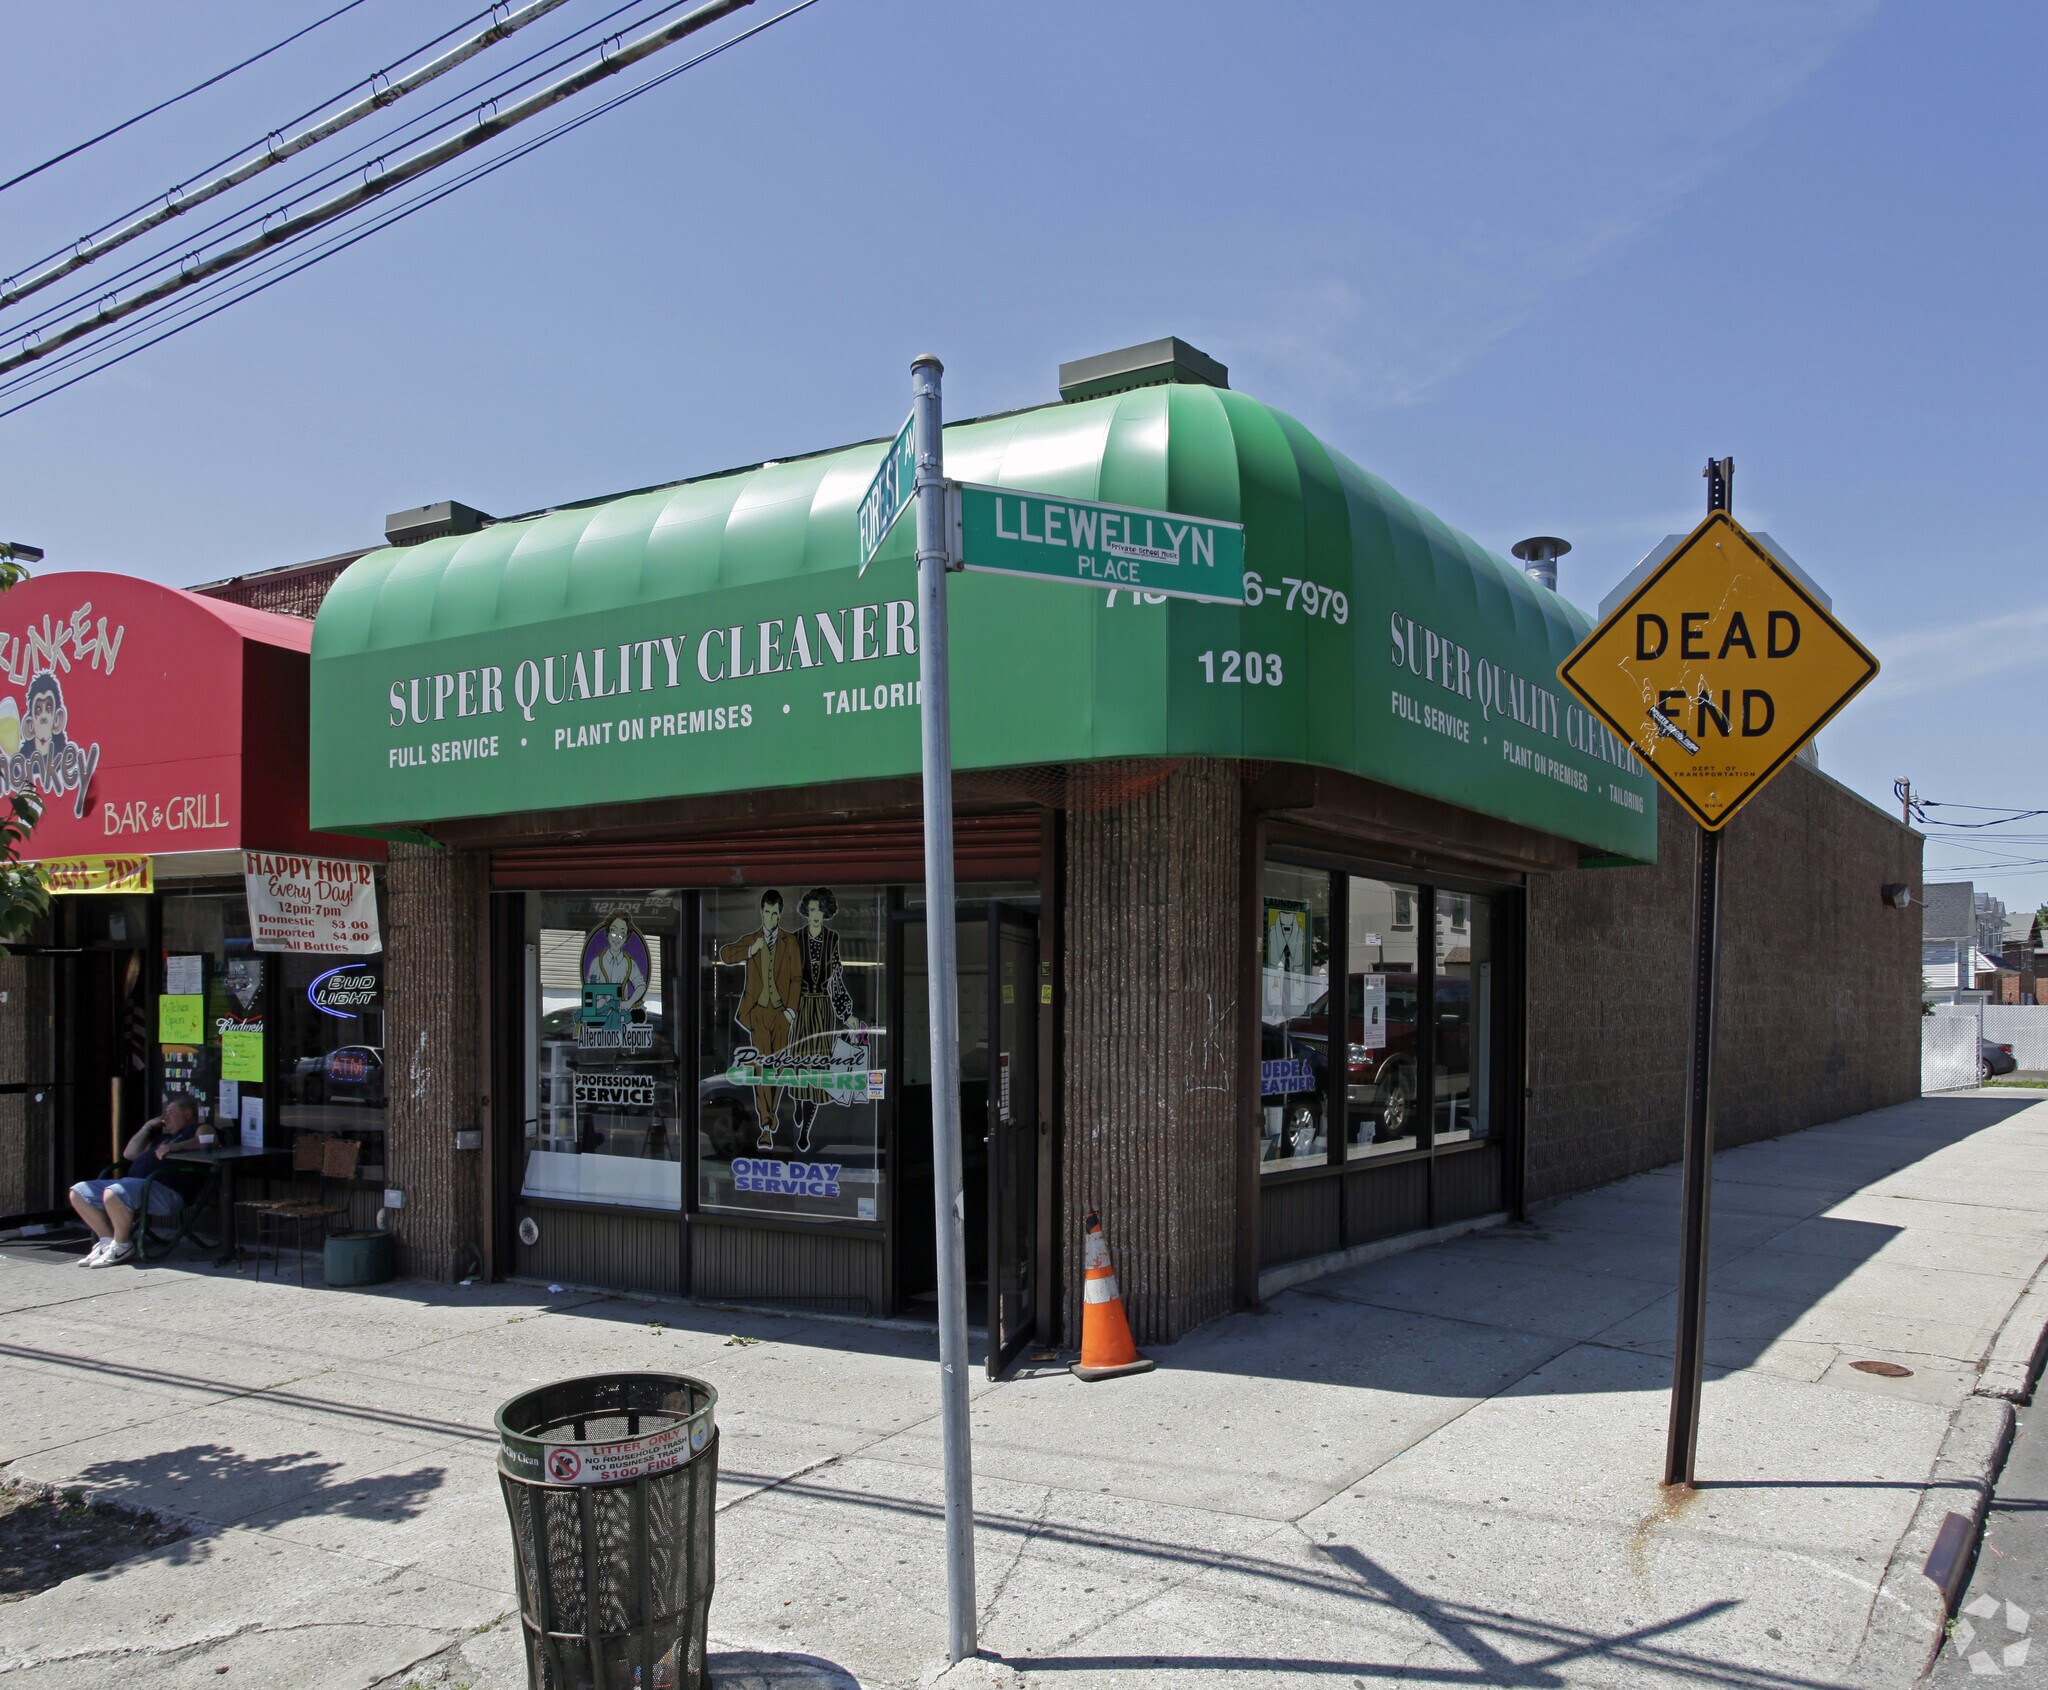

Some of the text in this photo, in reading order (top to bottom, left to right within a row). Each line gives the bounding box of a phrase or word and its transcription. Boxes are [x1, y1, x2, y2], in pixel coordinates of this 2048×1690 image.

[860, 446, 900, 562] FOREST
[996, 497, 1214, 567] LLEWELLYN
[1112, 543, 1137, 553] Private
[1139, 547, 1160, 556] School
[1161, 551, 1178, 559] Music
[1078, 555, 1141, 583] PLACE
[1636, 610, 1800, 661] DEAD
[389, 666, 505, 727] SUPER
[514, 634, 687, 722] QUALITY
[1198, 650, 1283, 686] 1203
[1390, 611, 1472, 700] SUPER
[1477, 658, 1560, 740] QUALITY
[1657, 689, 1775, 738] END
[389, 746, 427, 769] FULL
[431, 735, 499, 764] SERVICE
[555, 722, 613, 749] PLANT
[618, 718, 644, 742] ON
[650, 704, 752, 738] PREMISES
[1391, 691, 1644, 814] FULL SERVICE PLANT ON PREMISES TAILORING
[104, 801, 149, 836] BAR
[165, 793, 229, 829] GRILL
[247, 853, 371, 885] HAPPY HOUR
[268, 875, 354, 907] Every Day!
[258, 914, 315, 927] Domestic
[278, 901, 342, 917] 12pm-7pm
[260, 926, 316, 939] Imported
[284, 941, 349, 952] All Bottles
[328, 975, 376, 990] BUD
[316, 990, 378, 1005] LIGHT
[579, 1023, 652, 1052] Alterations Repairs
[164, 1052, 183, 1063] LIVE
[331, 1057, 363, 1075] ATM
[736, 1049, 865, 1067] Professional
[165, 1068, 192, 1079] EVERY
[575, 1075, 654, 1087] PROFESSIONAL
[726, 1066, 867, 1091] CLEANERS
[575, 1087, 654, 1103] SERVICE
[732, 1158, 841, 1181] ONE DAY
[736, 1177, 840, 1197] SERVICE
[593, 1429, 680, 1456] LITTER ONLY
[603, 1446, 660, 1462] HOUSEHOLD
[663, 1437, 687, 1449] TRASH
[517, 1452, 539, 1466] Clean
[600, 1455, 679, 1480] $100 FINE
[610, 1455, 655, 1470] BUSINESS
[657, 1446, 684, 1458] TRASH
